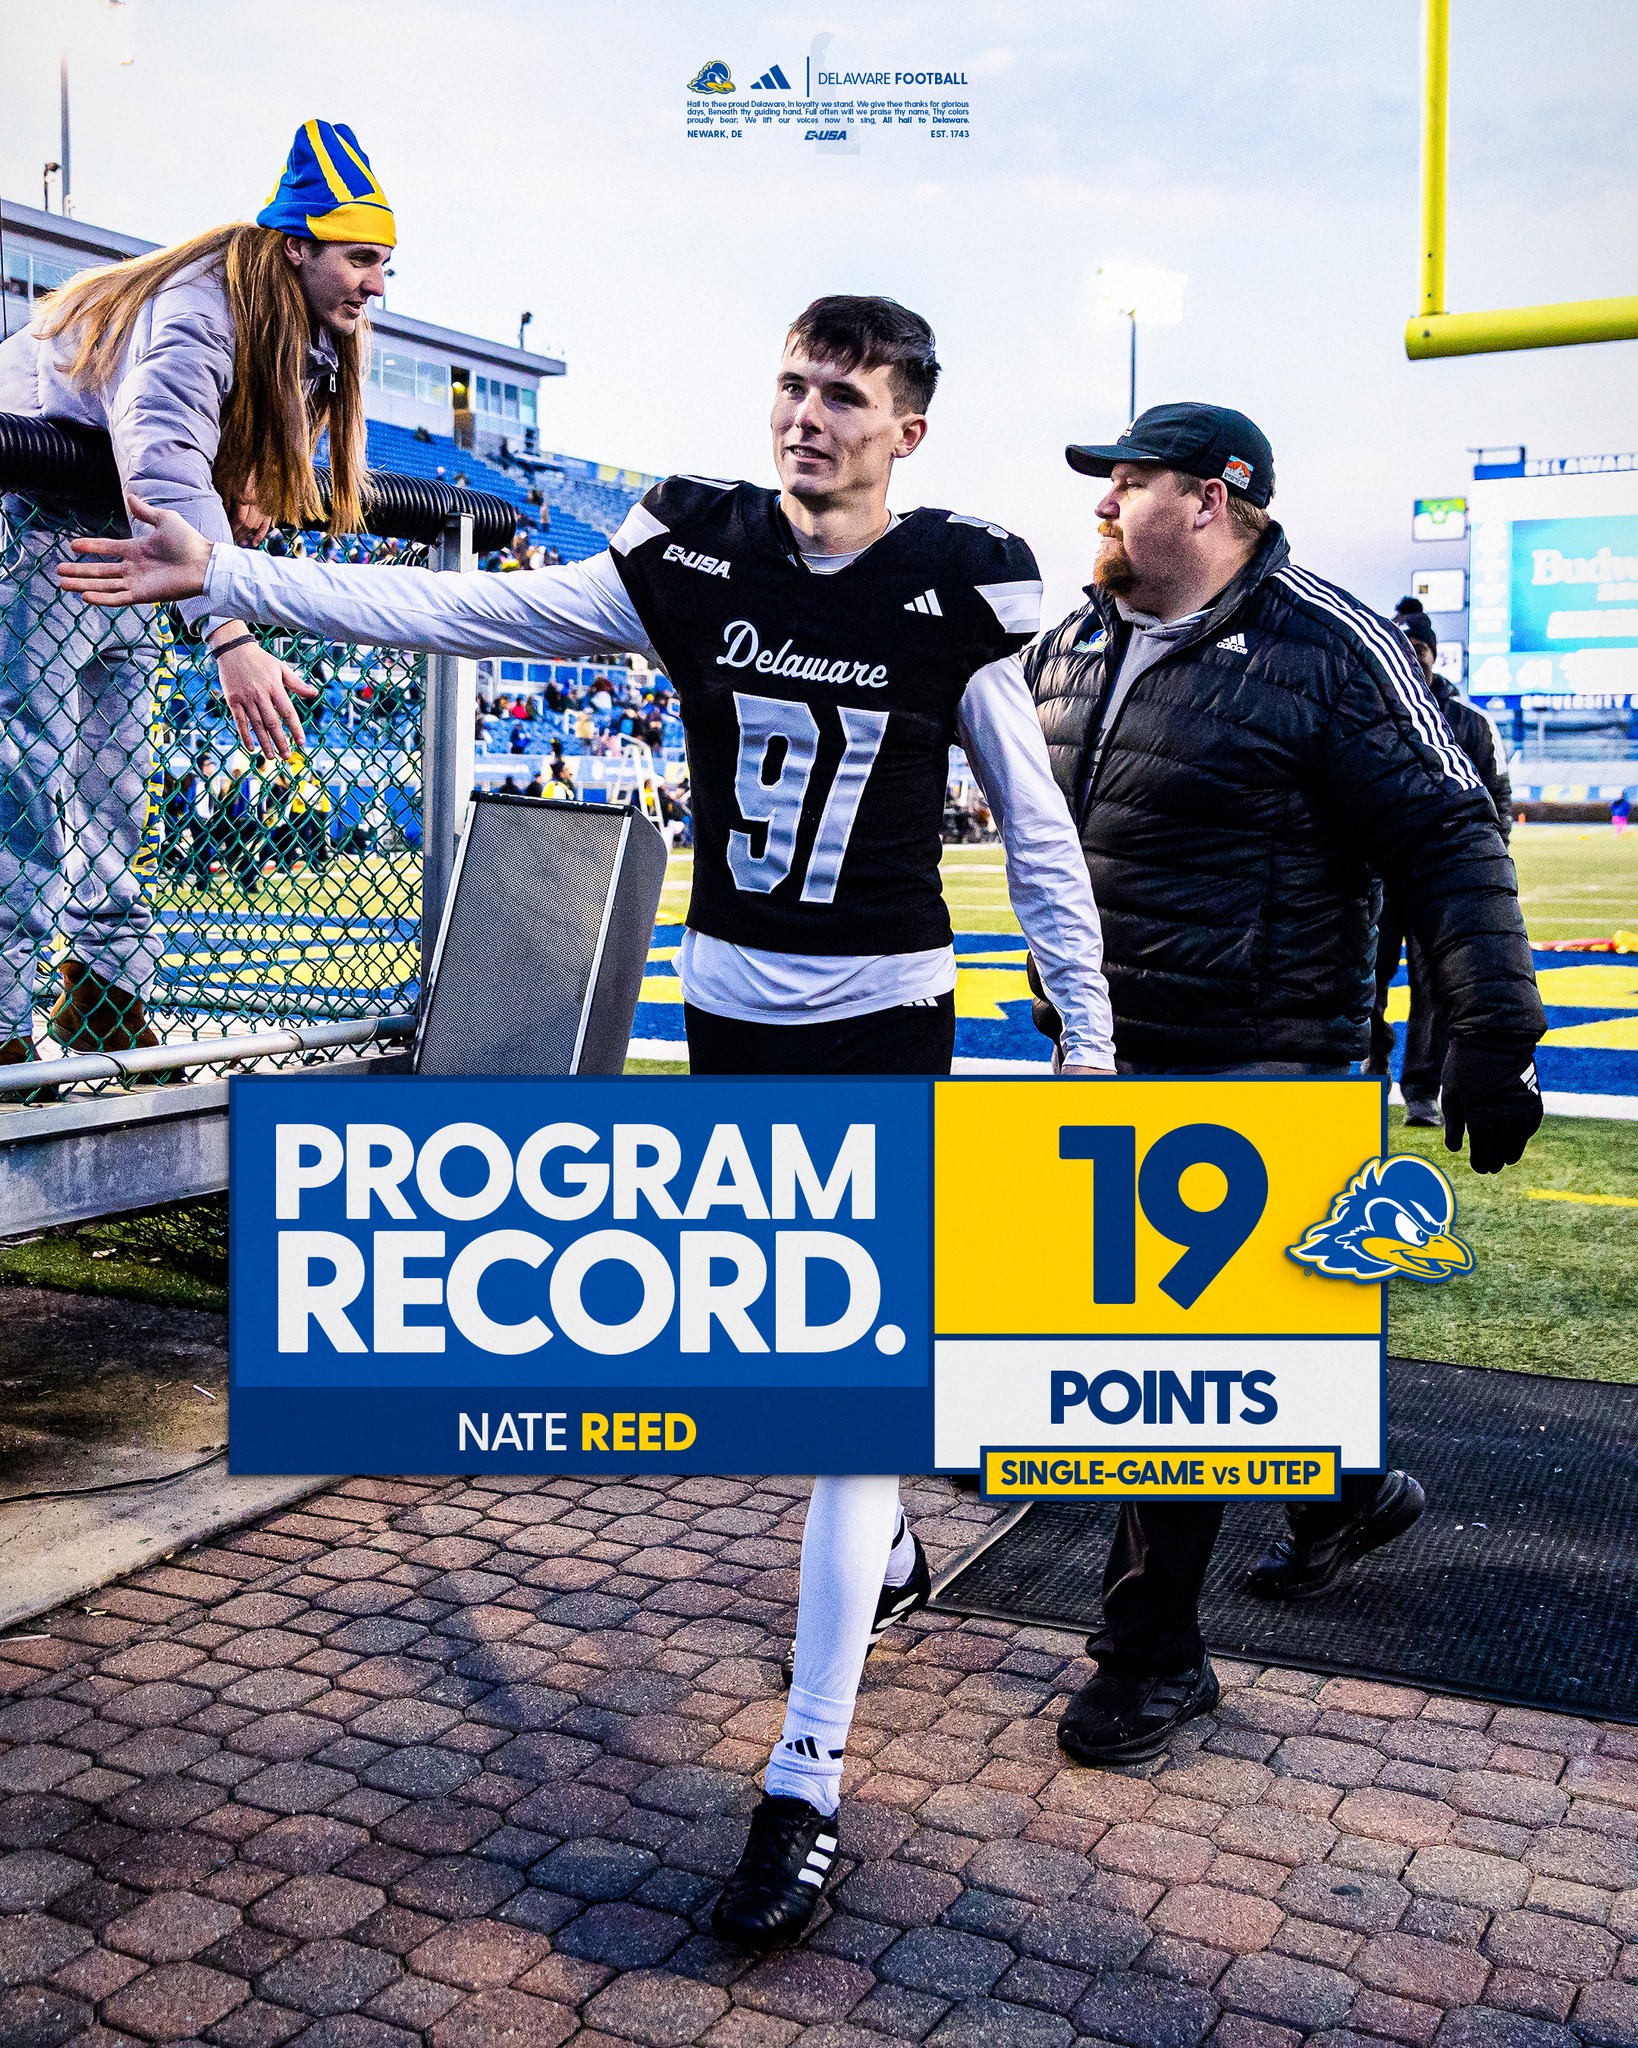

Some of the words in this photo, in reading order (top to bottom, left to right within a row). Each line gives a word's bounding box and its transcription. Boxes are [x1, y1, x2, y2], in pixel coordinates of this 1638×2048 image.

[716, 620, 889, 688] Delaware
[1216, 641, 1248, 655] adidas
[726, 692, 890, 905] 91
